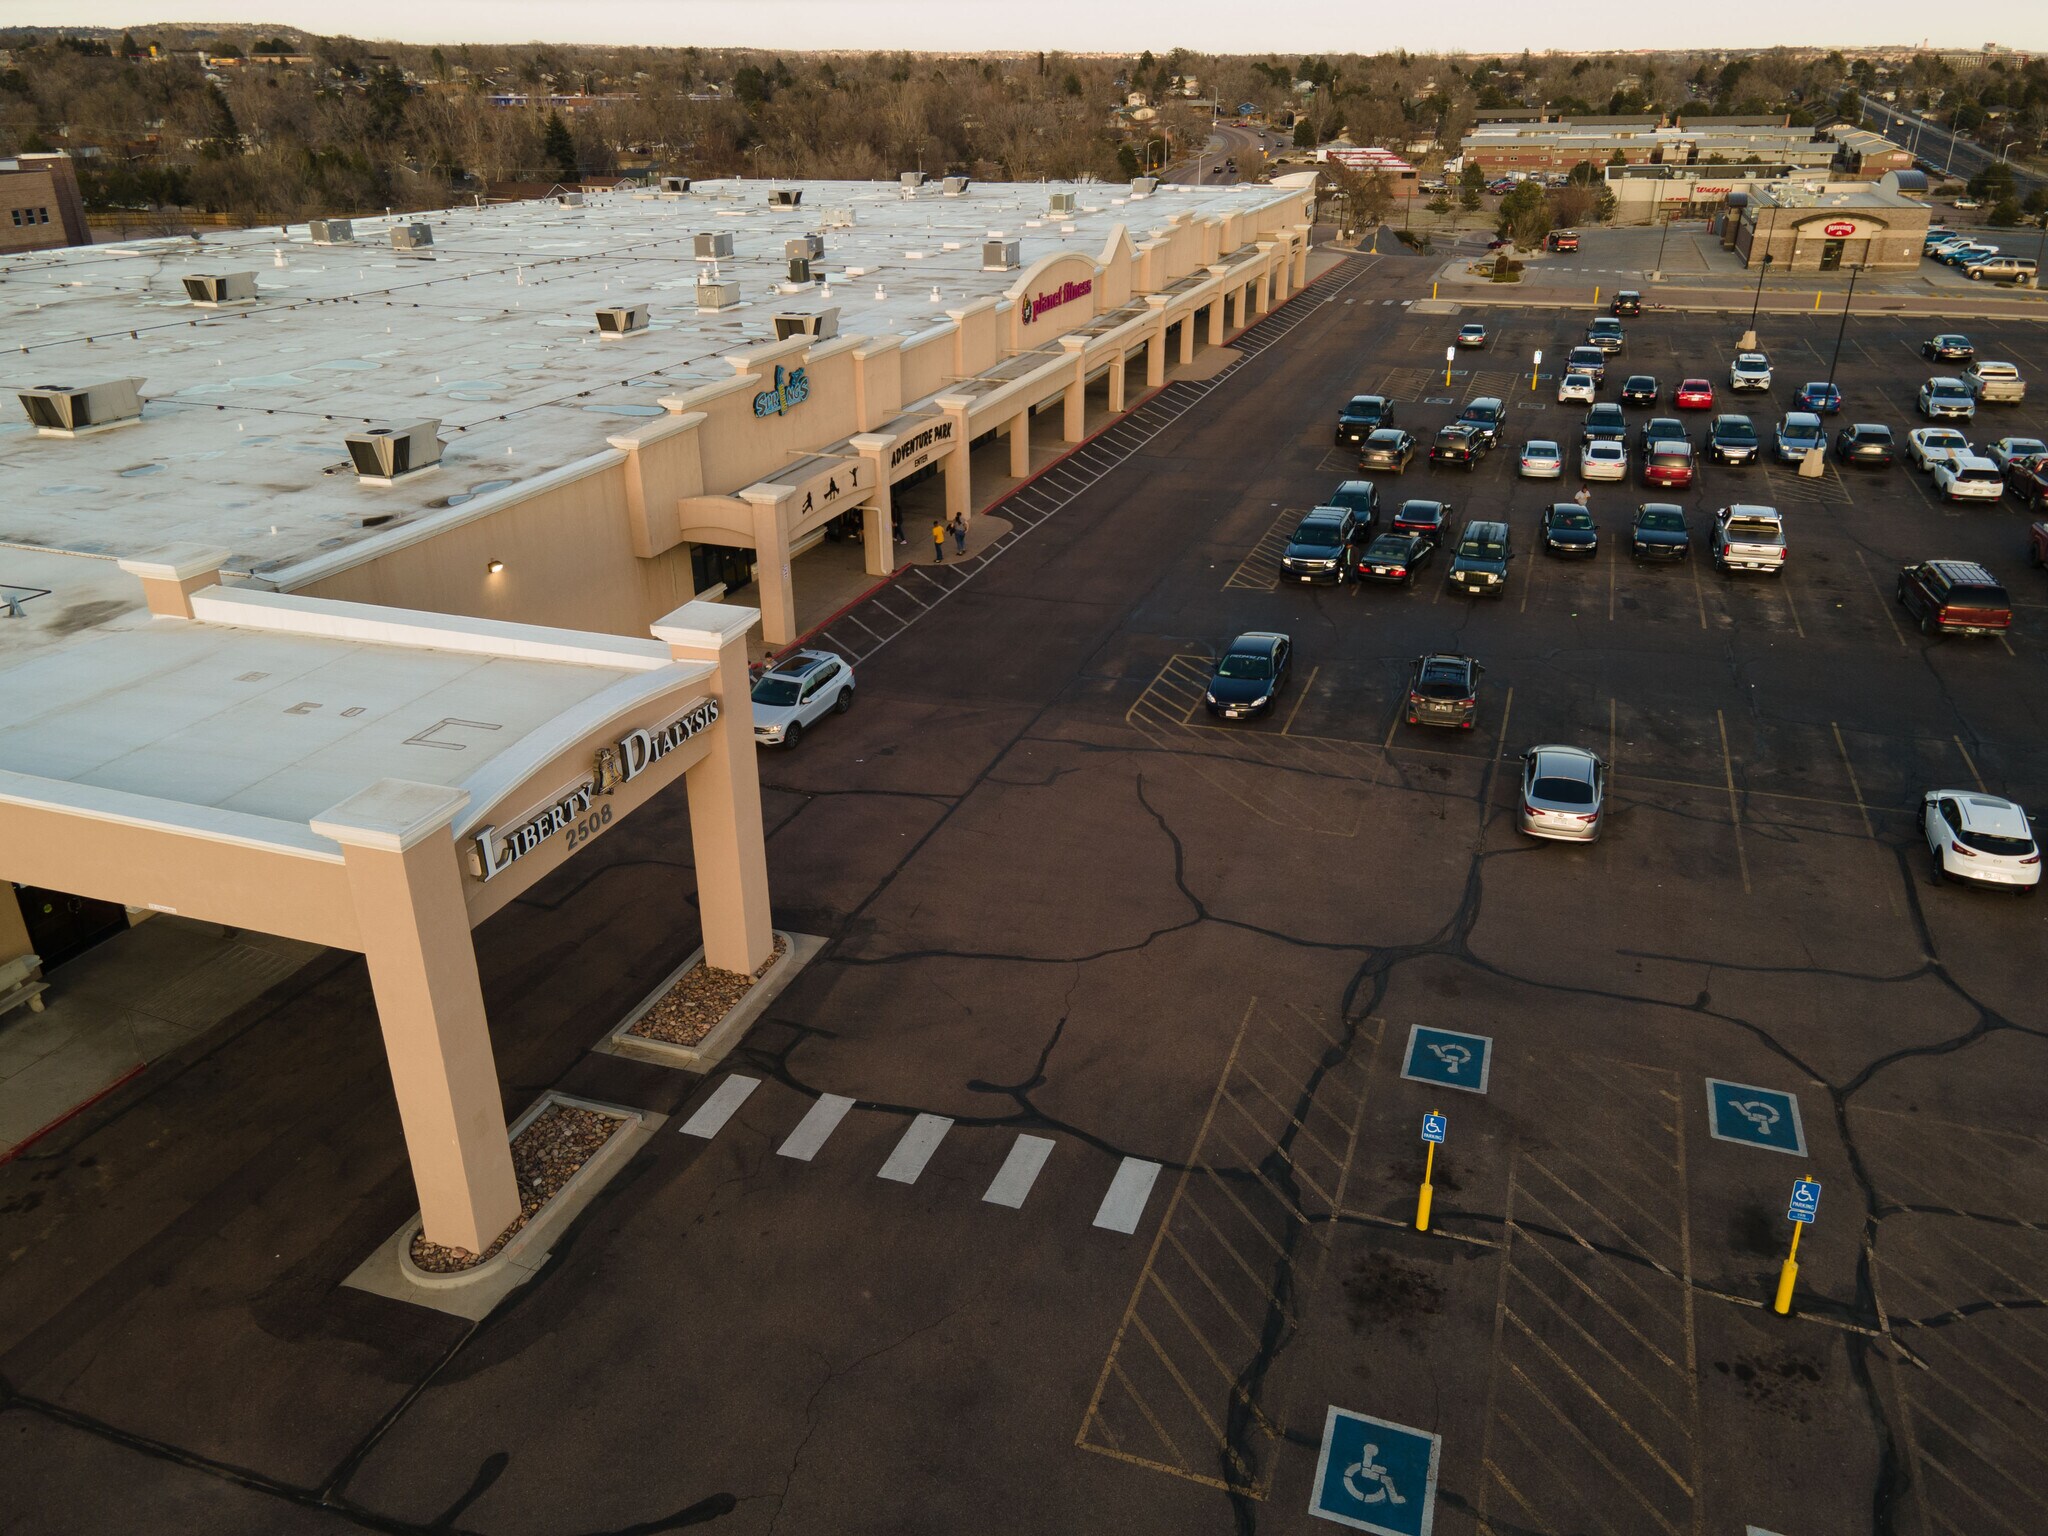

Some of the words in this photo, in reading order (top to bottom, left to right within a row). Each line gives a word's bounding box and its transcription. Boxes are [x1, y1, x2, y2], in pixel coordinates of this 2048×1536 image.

[1032, 286, 1063, 322] planet
[1063, 279, 1092, 304] fitness
[891, 428, 933, 468] ADVENTURE
[934, 422, 952, 441] PARK
[914, 454, 928, 467] ENTER
[565, 803, 613, 851] 2508
[1792, 1201, 1815, 1211] PARKING
